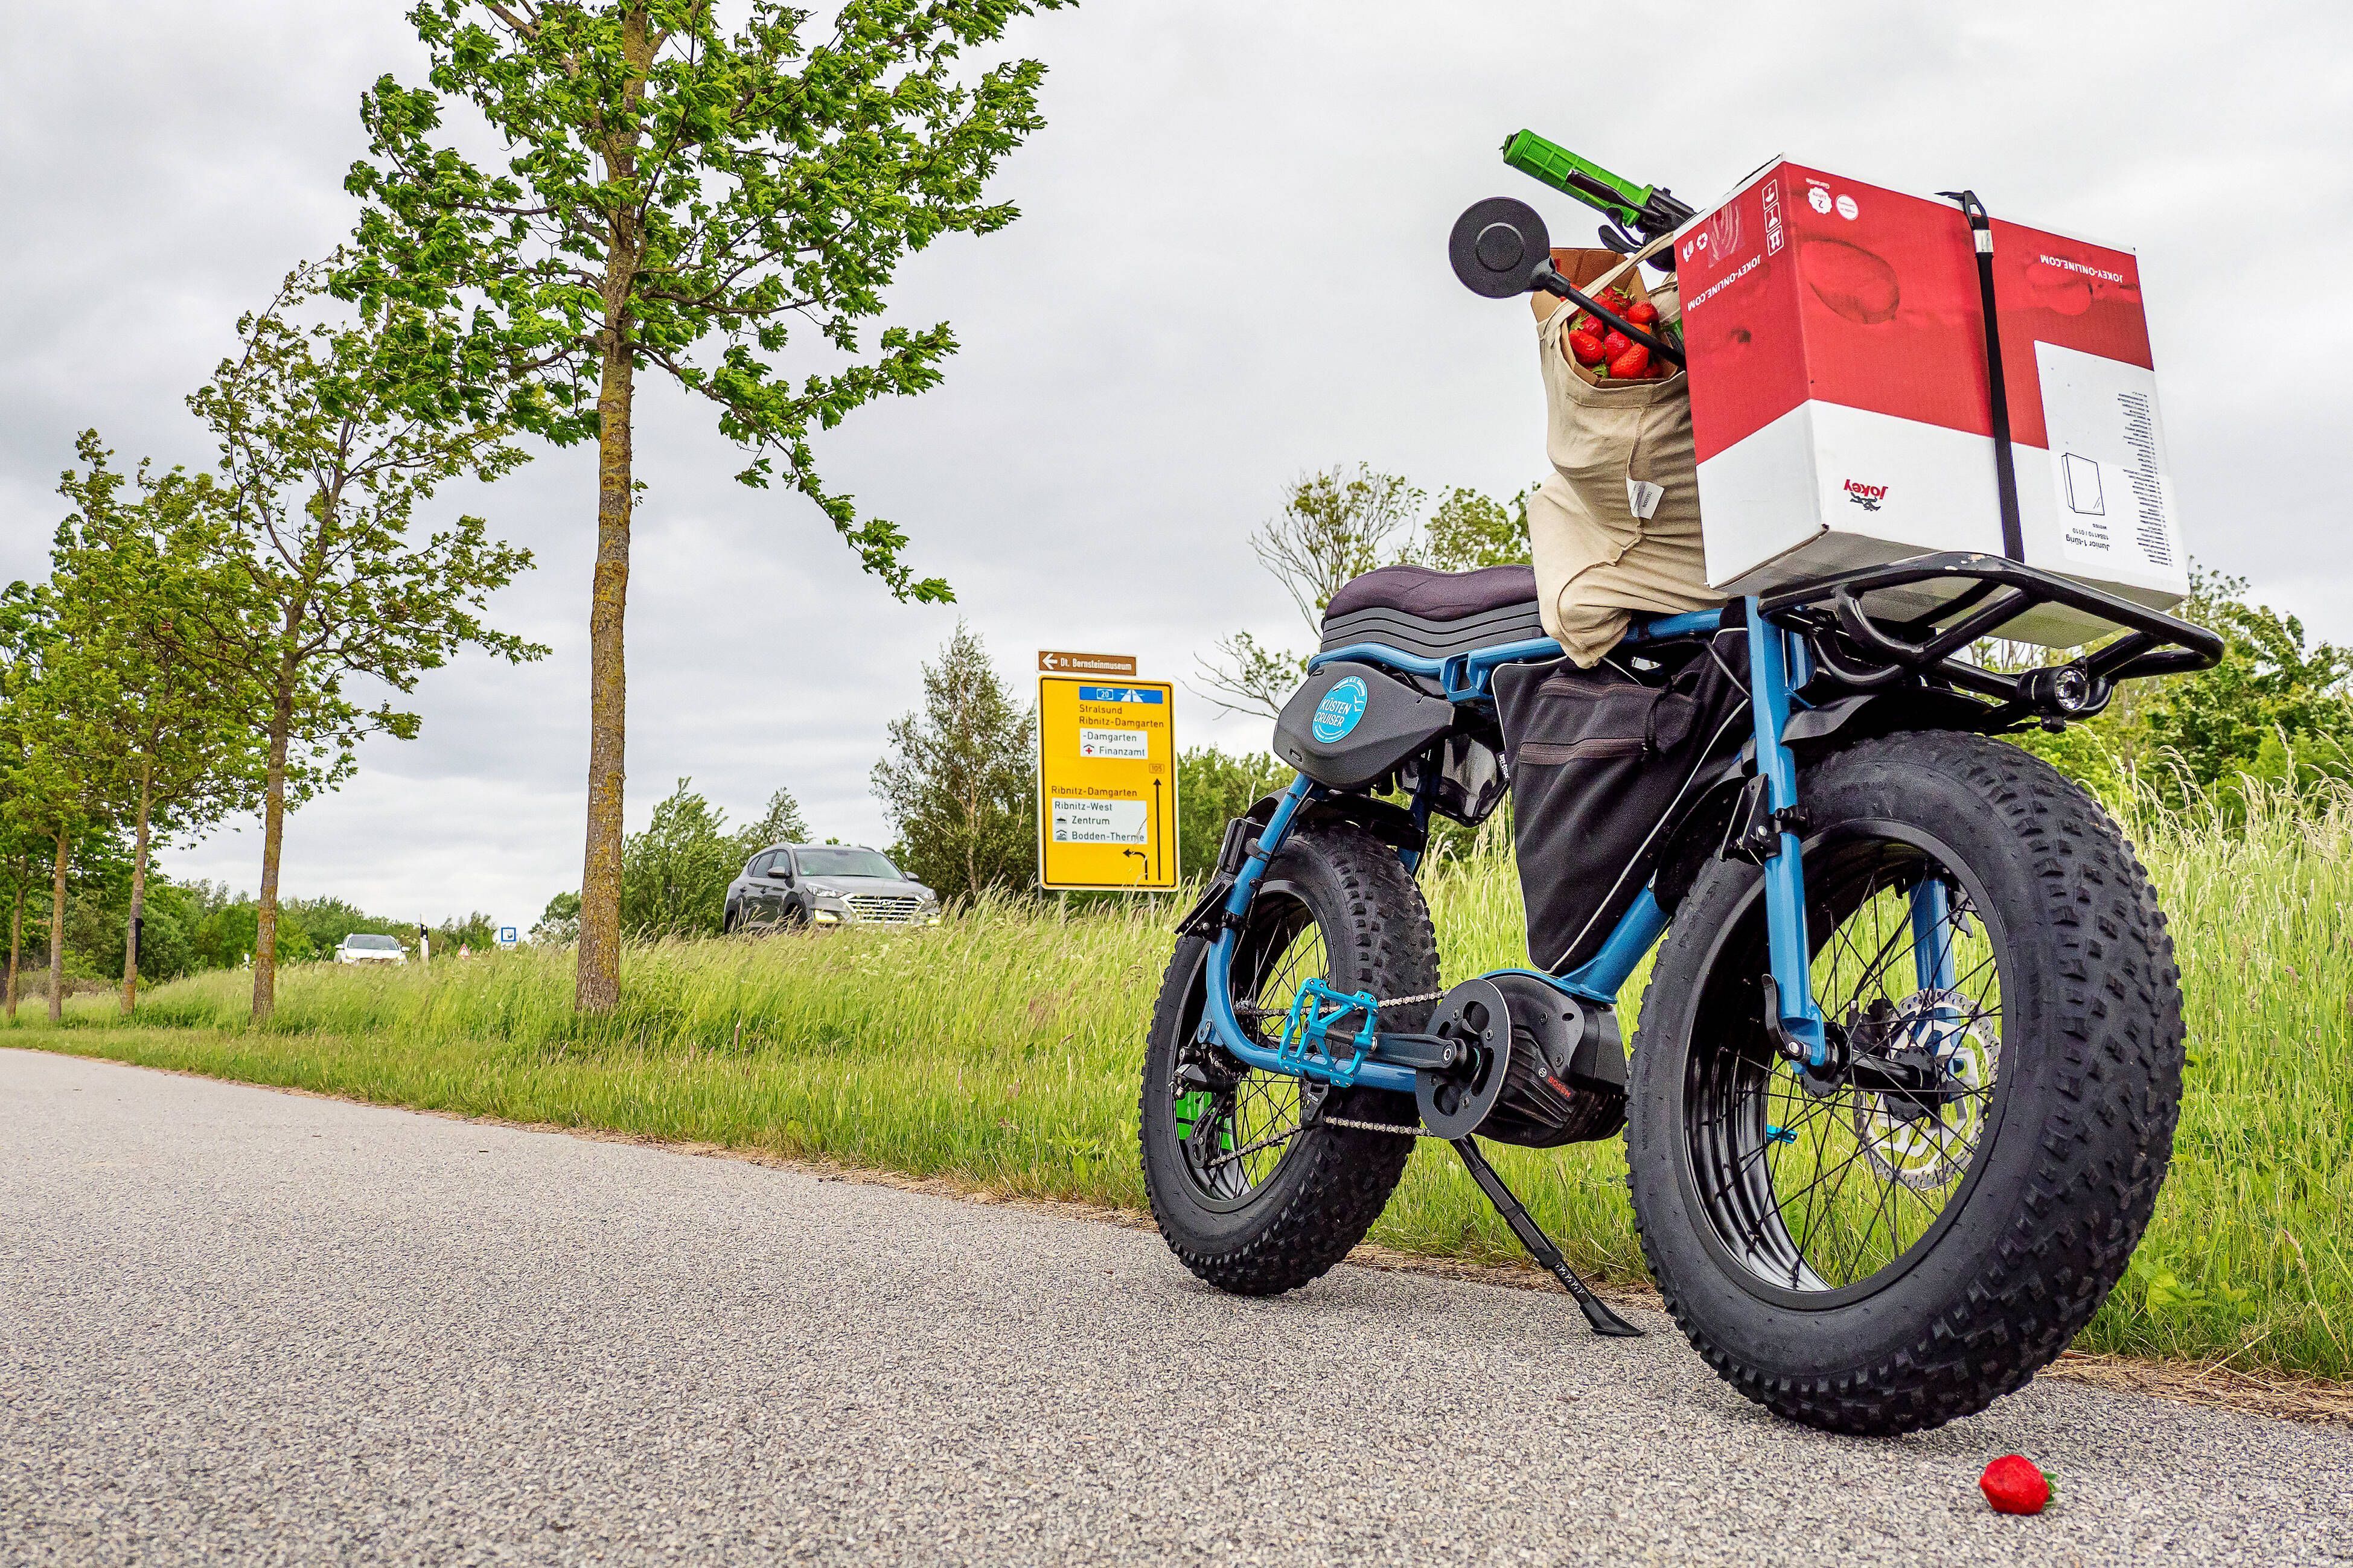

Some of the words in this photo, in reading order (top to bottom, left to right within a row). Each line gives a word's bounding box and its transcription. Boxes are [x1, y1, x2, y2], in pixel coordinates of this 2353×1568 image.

[1818, 199, 1824, 209] 2
[2040, 253, 2124, 284] JOKEY-ONLINE.COM
[1687, 253, 1761, 311] JOKEY-ONLINE.COM
[2066, 534, 2087, 546] 1-türig
[2089, 541, 2110, 551] Junior
[1072, 658, 1132, 671] Bernsteinmuseum
[1079, 704, 1122, 715] Stralsund
[1320, 697, 1352, 715] KÜSTEN
[1079, 716, 1164, 729] Ribnitz-Damgarten
[1314, 712, 1345, 727] CRUISER
[1083, 731, 1137, 743] -Damgarten
[1099, 746, 1145, 756] Finanzamt
[1151, 765, 1162, 773] 105
[1052, 785, 1137, 798] Ribnitz-Damgarten
[1055, 801, 1113, 811] Ribnitz-West
[1071, 815, 1110, 825] Zentrum
[1071, 831, 1145, 842] Bodden-Therme
[1548, 1076, 1571, 1097] BOSCH
